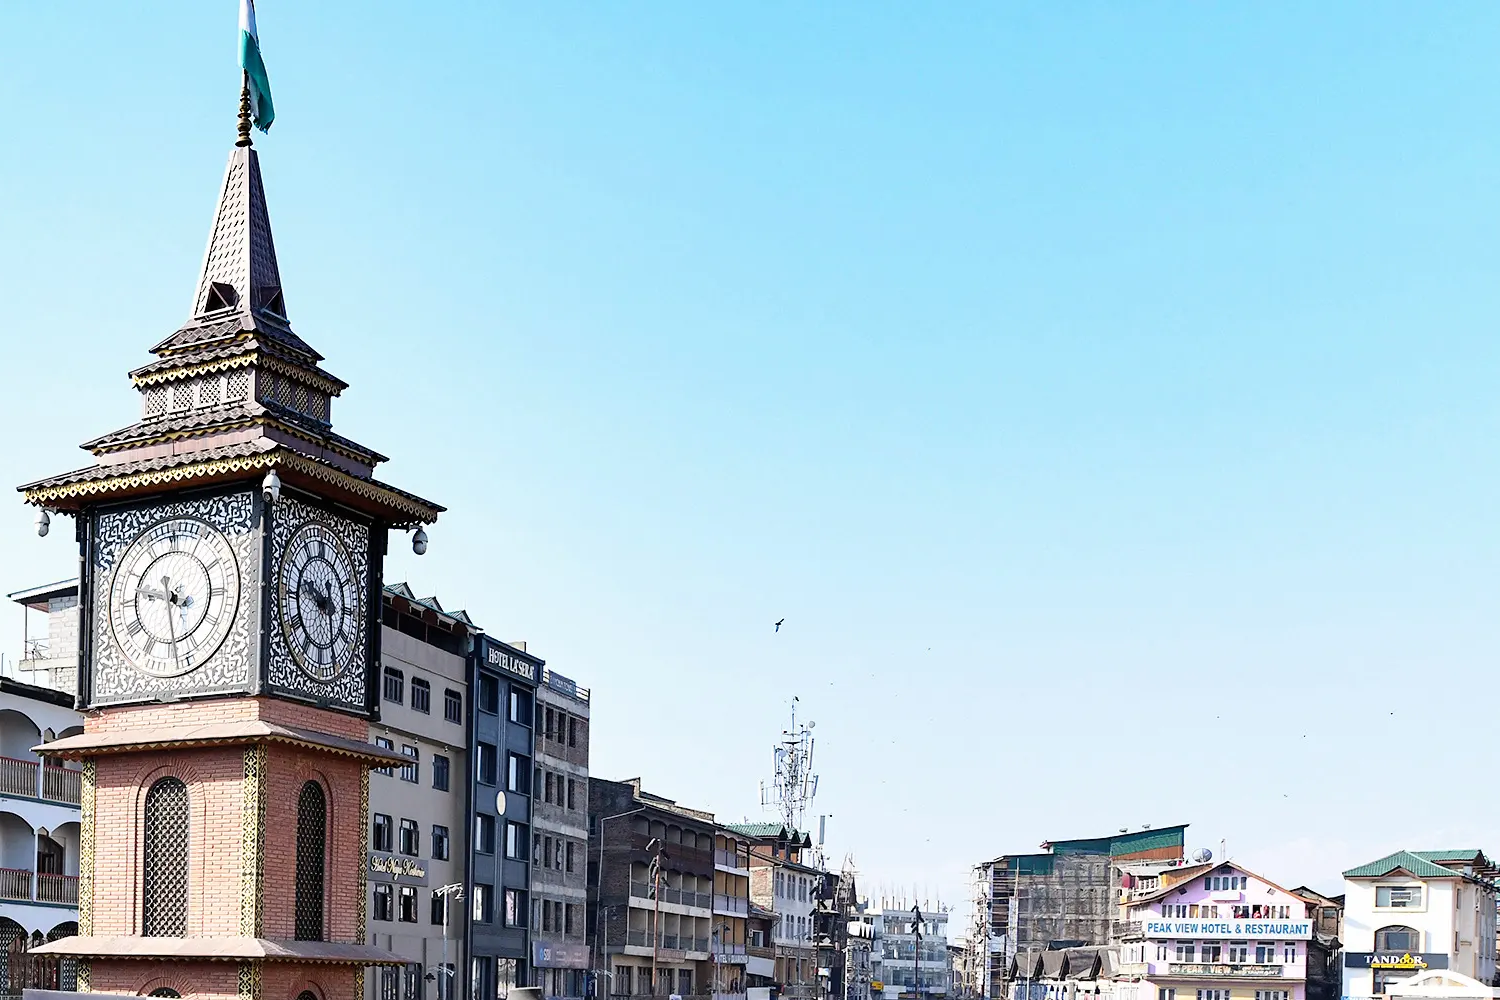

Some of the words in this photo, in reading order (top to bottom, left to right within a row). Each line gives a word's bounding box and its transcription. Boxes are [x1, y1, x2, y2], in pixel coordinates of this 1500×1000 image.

[488, 647, 509, 670] HOTEL
[1148, 922, 1172, 933] PEAK
[1174, 923, 1199, 934] VIEW
[1201, 923, 1232, 934] HOTEL
[1234, 924, 1242, 934] &
[1245, 924, 1309, 935] RESTAURANT
[1181, 965, 1204, 974] PEAK
[1210, 965, 1231, 974] VIEW
